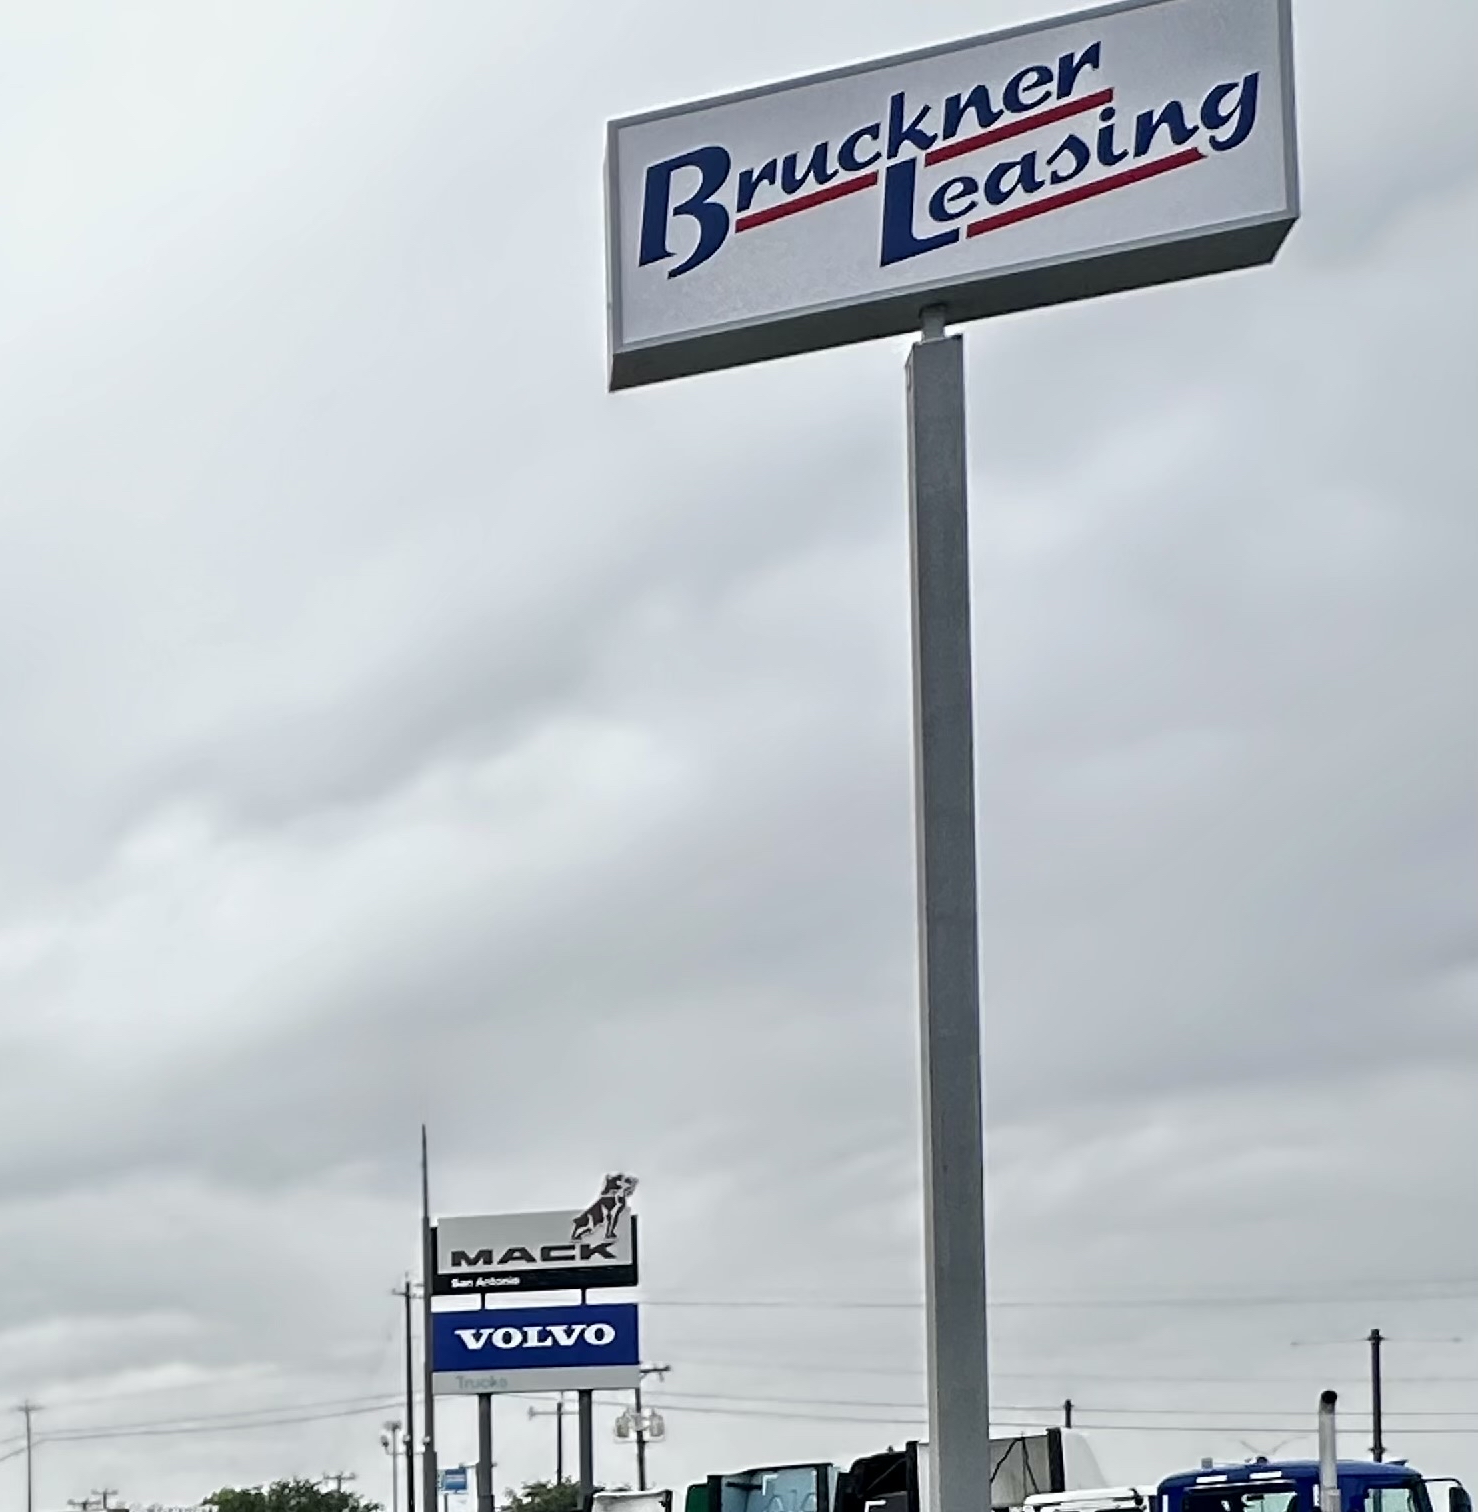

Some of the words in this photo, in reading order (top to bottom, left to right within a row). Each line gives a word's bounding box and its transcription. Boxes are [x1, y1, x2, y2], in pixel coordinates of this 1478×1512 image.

[638, 40, 1101, 279] Bruckner
[880, 72, 1260, 267] Leasing
[450, 1242, 617, 1267] MACK
[451, 1278, 473, 1288] San
[454, 1323, 616, 1350] VOLVO
[456, 1376, 508, 1389] Trucks
